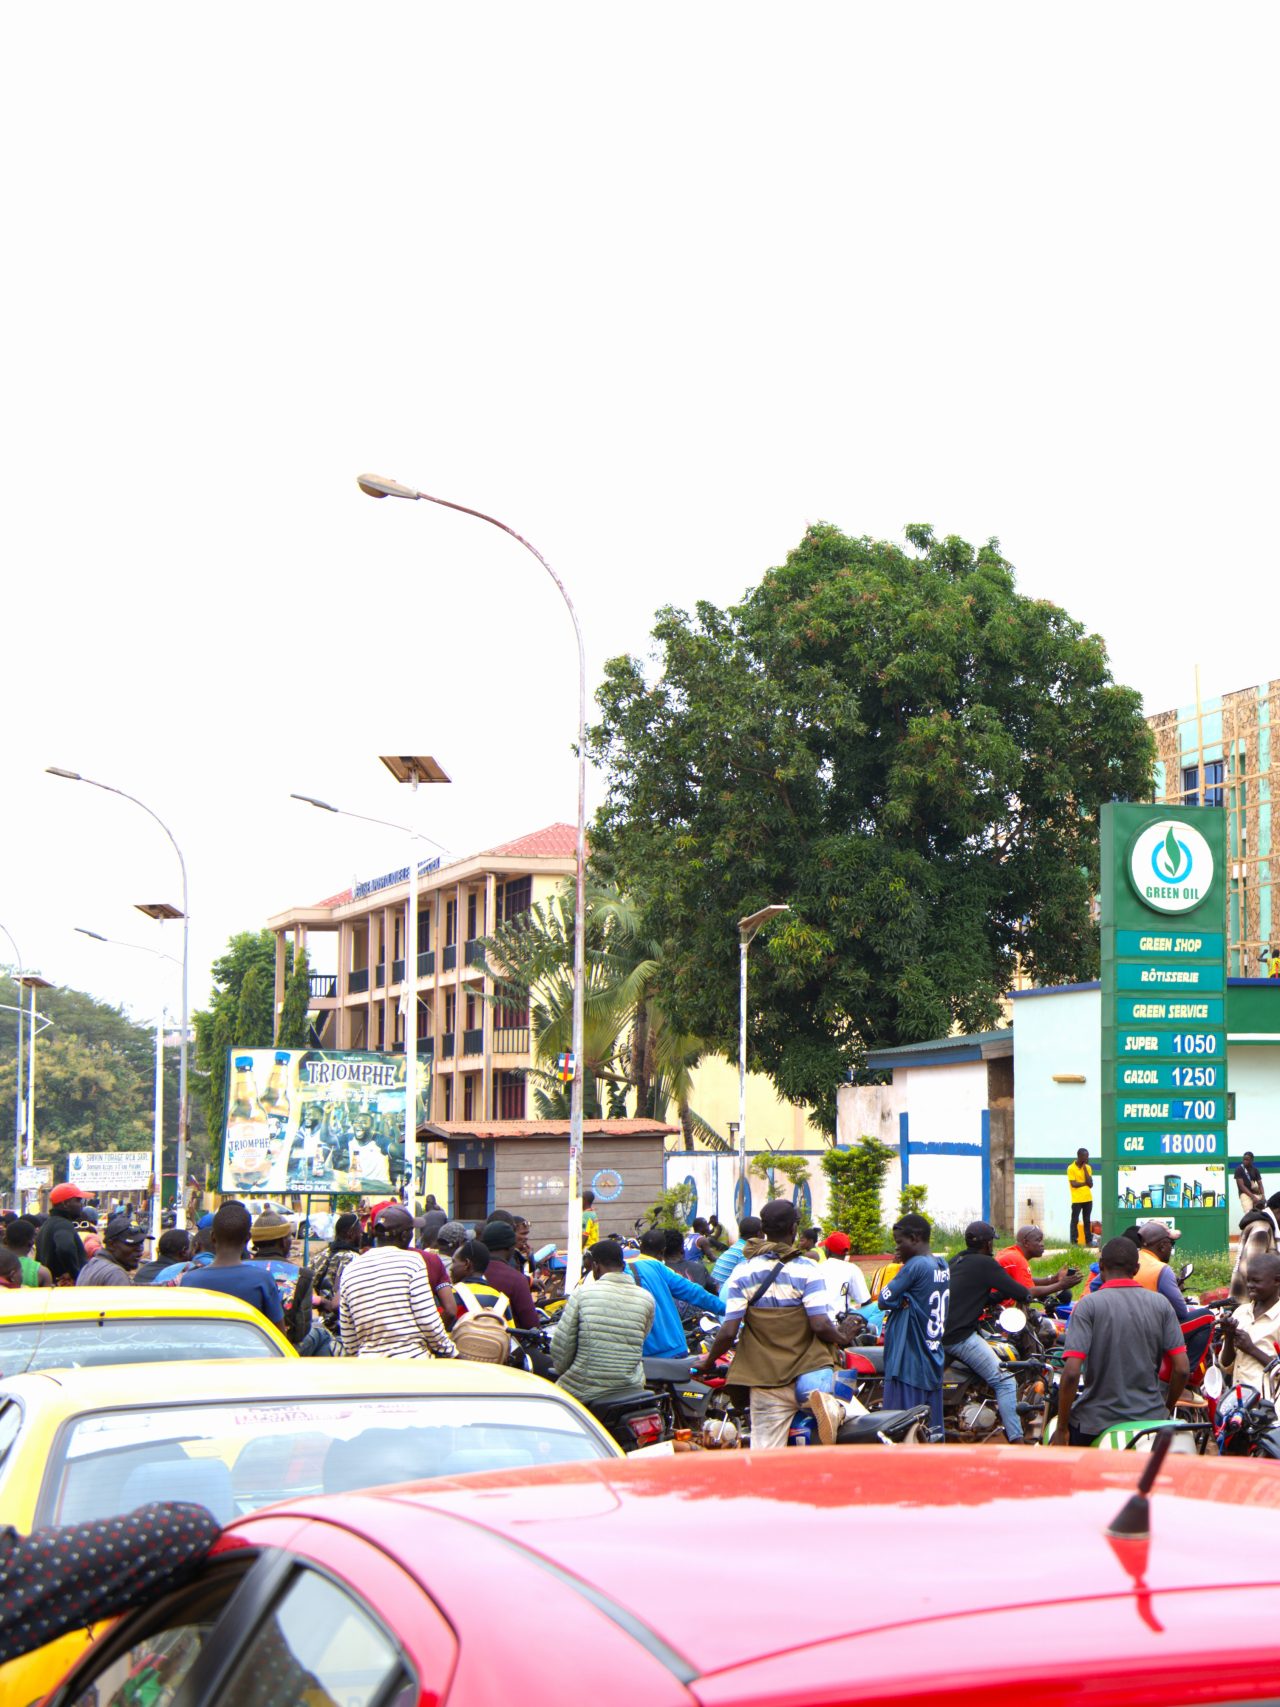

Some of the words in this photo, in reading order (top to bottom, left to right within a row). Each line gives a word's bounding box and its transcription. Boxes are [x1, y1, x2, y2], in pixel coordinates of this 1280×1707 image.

[1146, 887, 1179, 899] GREEN
[1183, 888, 1200, 900] OIL
[1139, 937, 1173, 951] GREEN
[1174, 938, 1202, 953] SHOP
[1140, 968, 1199, 983] RÔTISSERIE
[1132, 1004, 1166, 1018] GREEN
[1168, 1004, 1208, 1019] SERVICE
[1124, 1036, 1159, 1051] SUPER
[1173, 1034, 1216, 1054] 1050
[307, 1062, 397, 1087] TRIOMPHE
[1123, 1069, 1159, 1084] GAZOIL
[1171, 1066, 1216, 1087] 1250
[1123, 1103, 1170, 1118] PETROLE
[1183, 1100, 1216, 1120] 700
[229, 1136, 271, 1151] TRIOMPHE
[1123, 1136, 1145, 1151] GAZ
[1161, 1133, 1217, 1154] 18000
